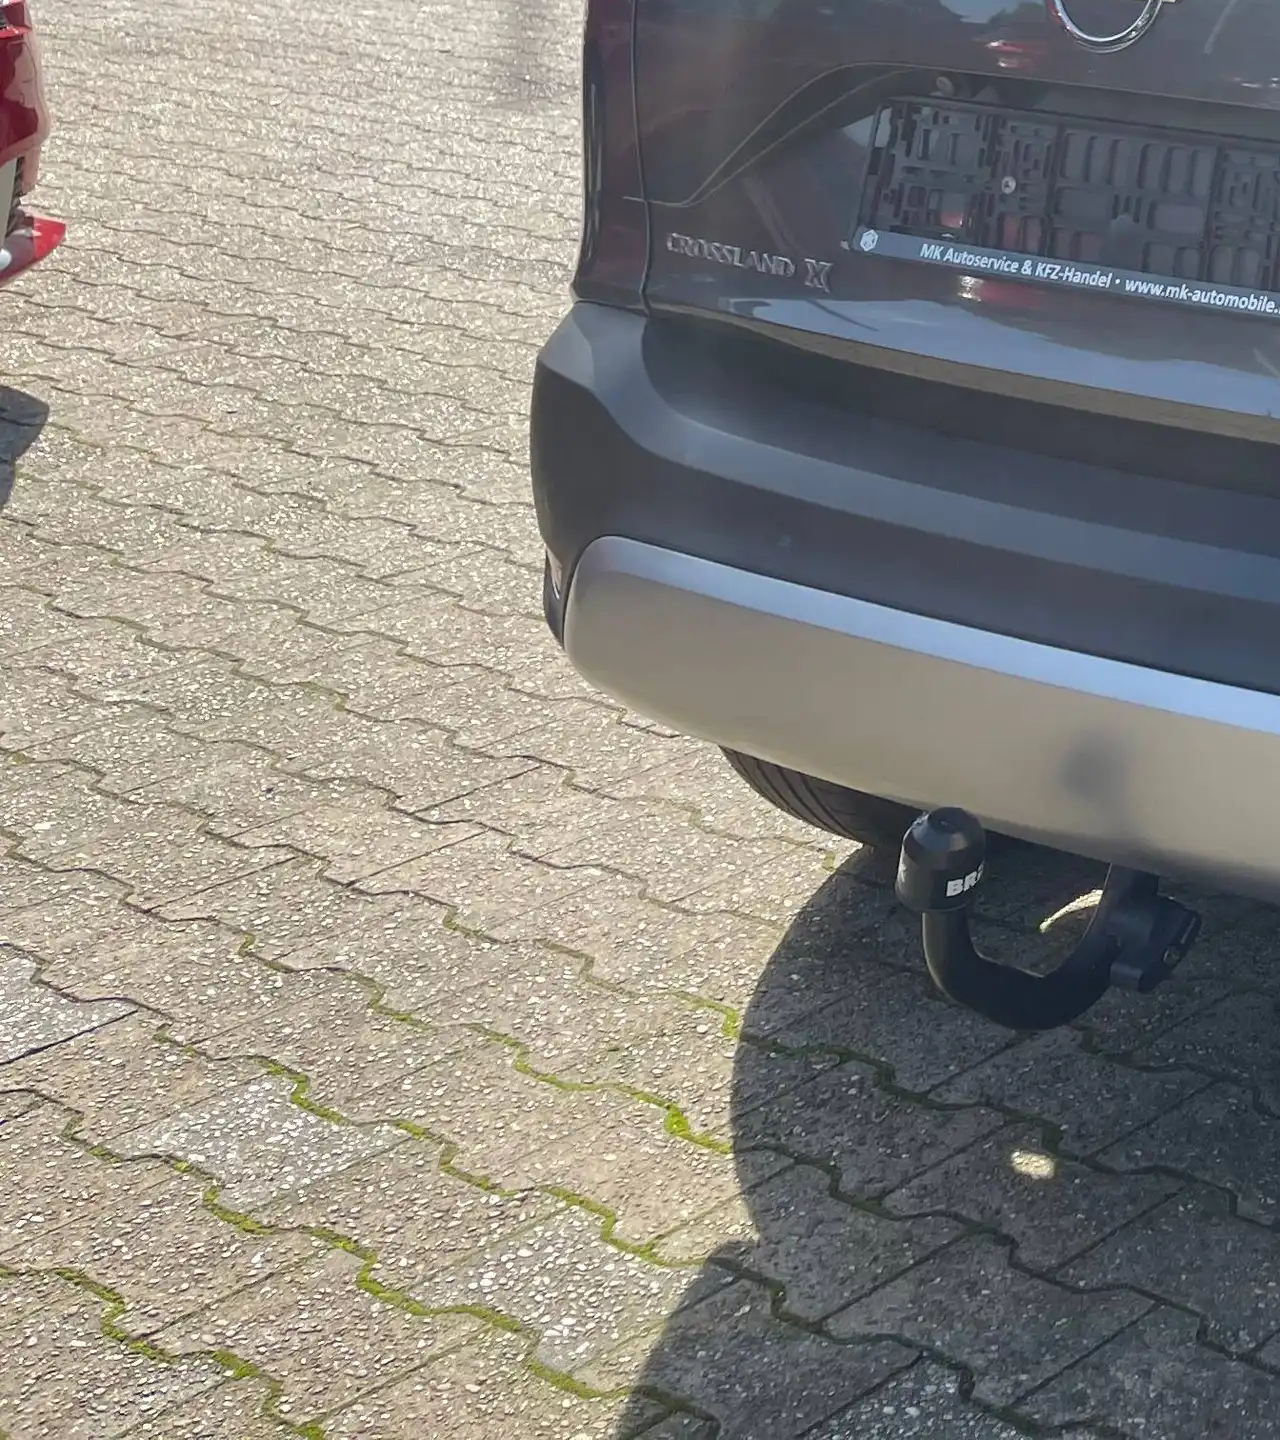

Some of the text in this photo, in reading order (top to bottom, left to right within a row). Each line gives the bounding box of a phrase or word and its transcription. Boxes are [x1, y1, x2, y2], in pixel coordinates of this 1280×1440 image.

[666, 231, 834, 294] CROSSLAND X
[920, 243, 943, 261] MK
[943, 247, 1019, 275] Autoservice
[1020, 259, 1033, 275] &
[1035, 261, 1113, 288] KFZ-Handel
